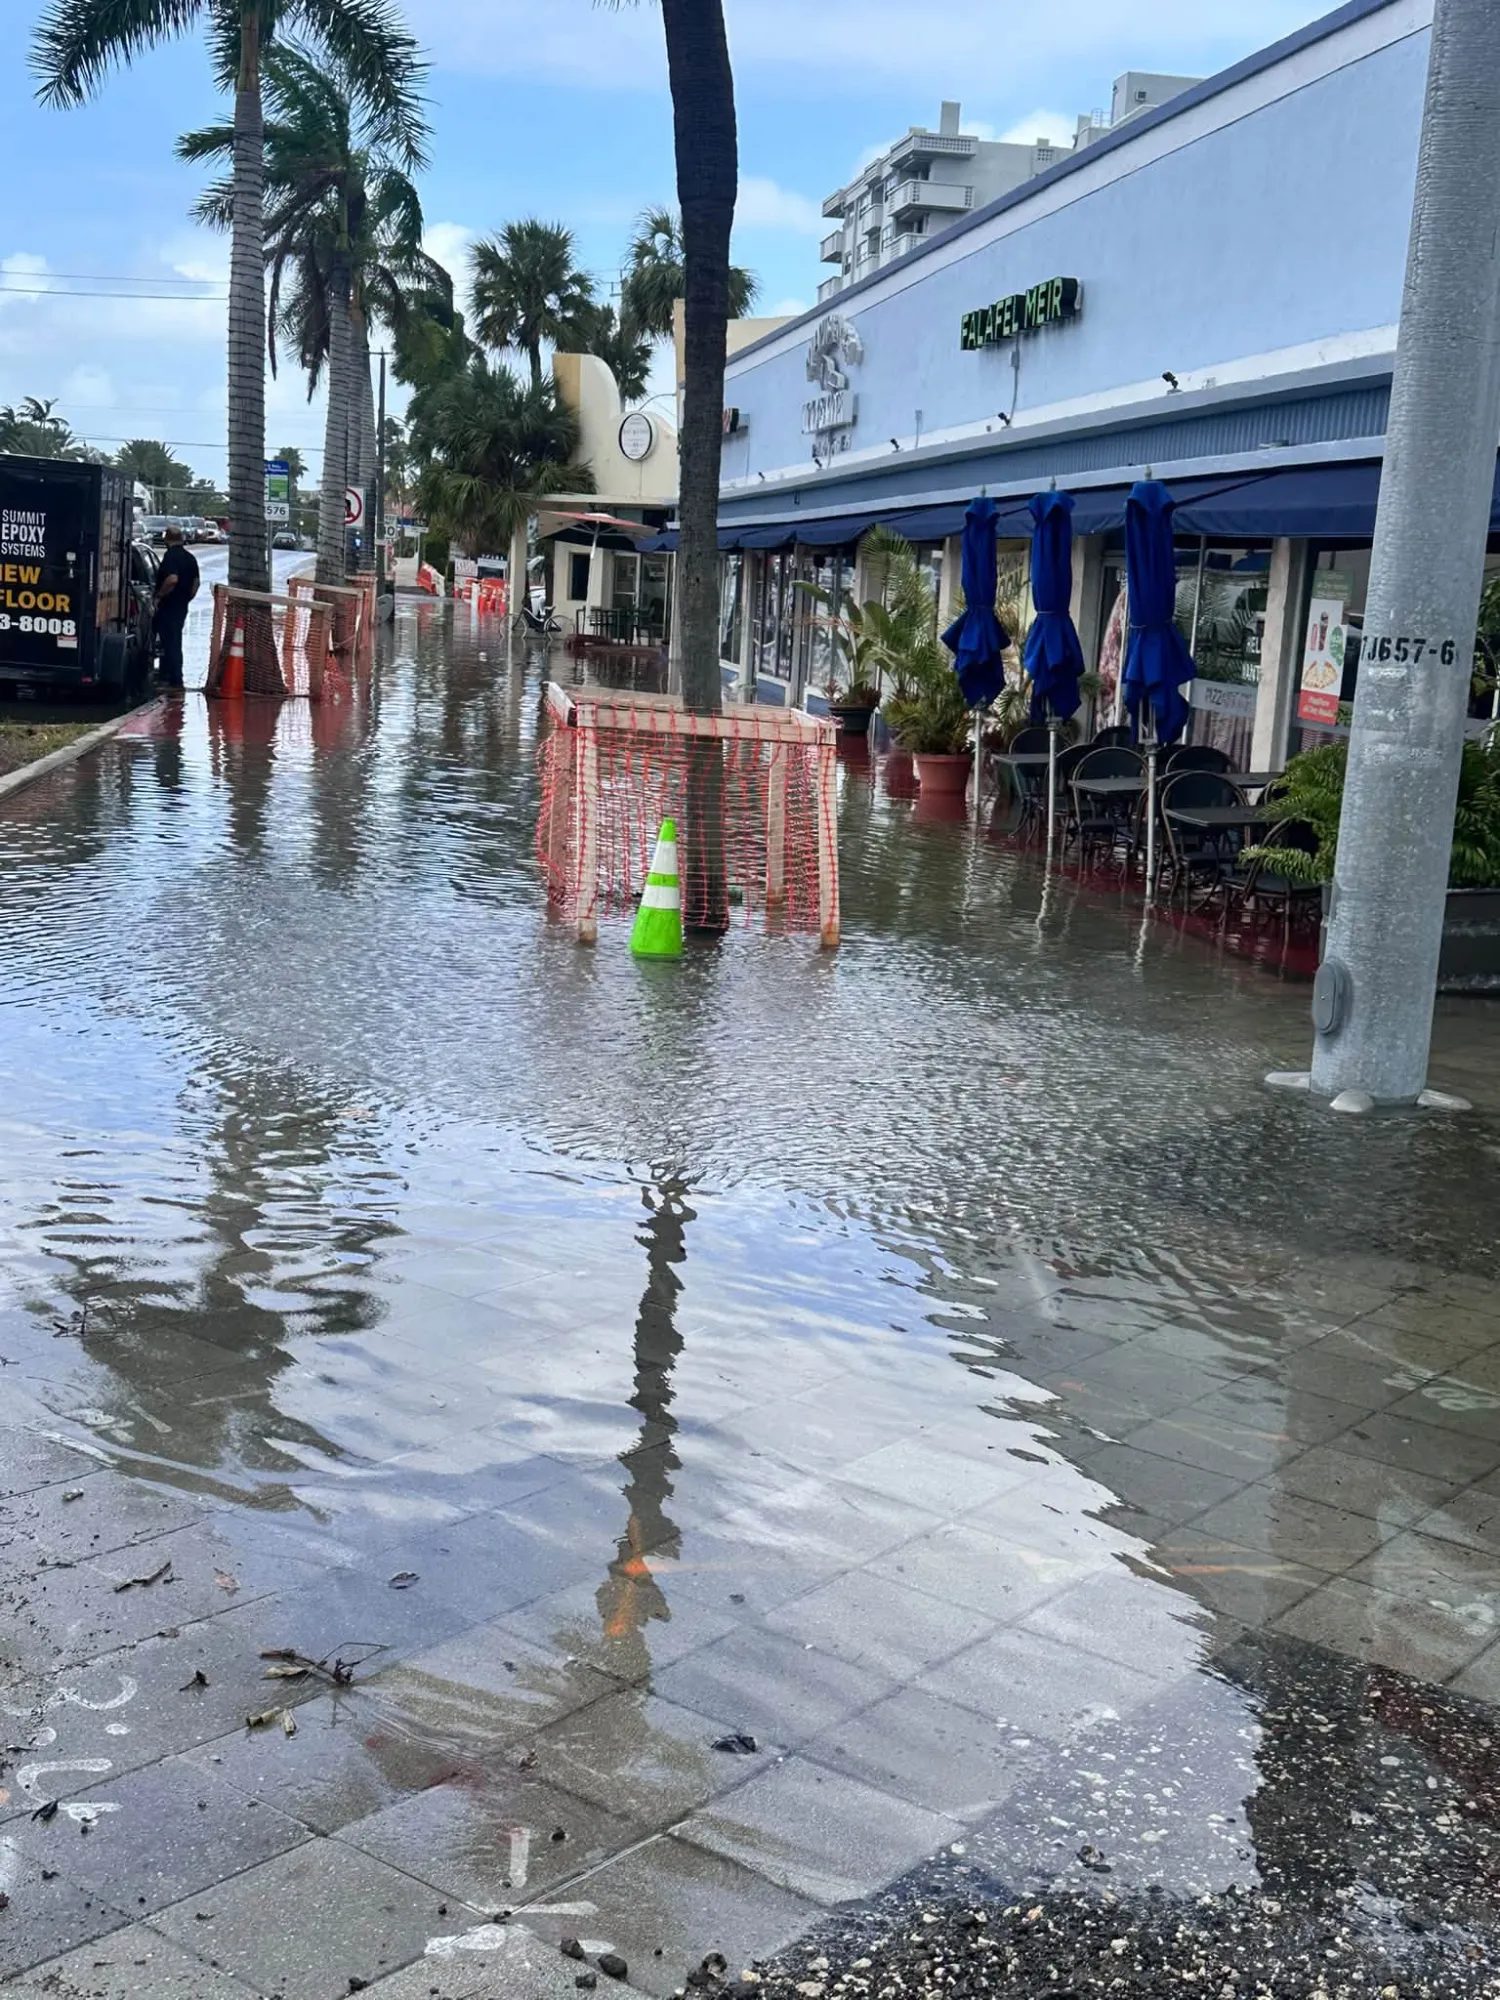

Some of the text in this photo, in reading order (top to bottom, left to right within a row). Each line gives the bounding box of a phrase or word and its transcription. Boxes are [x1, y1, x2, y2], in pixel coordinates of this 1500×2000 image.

[961, 277, 1063, 350] FALAFEL MEIR
[2, 509, 46, 525] SUMMIT
[1, 523, 45, 543] EPOXY
[1, 542, 45, 558] SYSTEMS
[0, 563, 41, 584] EW
